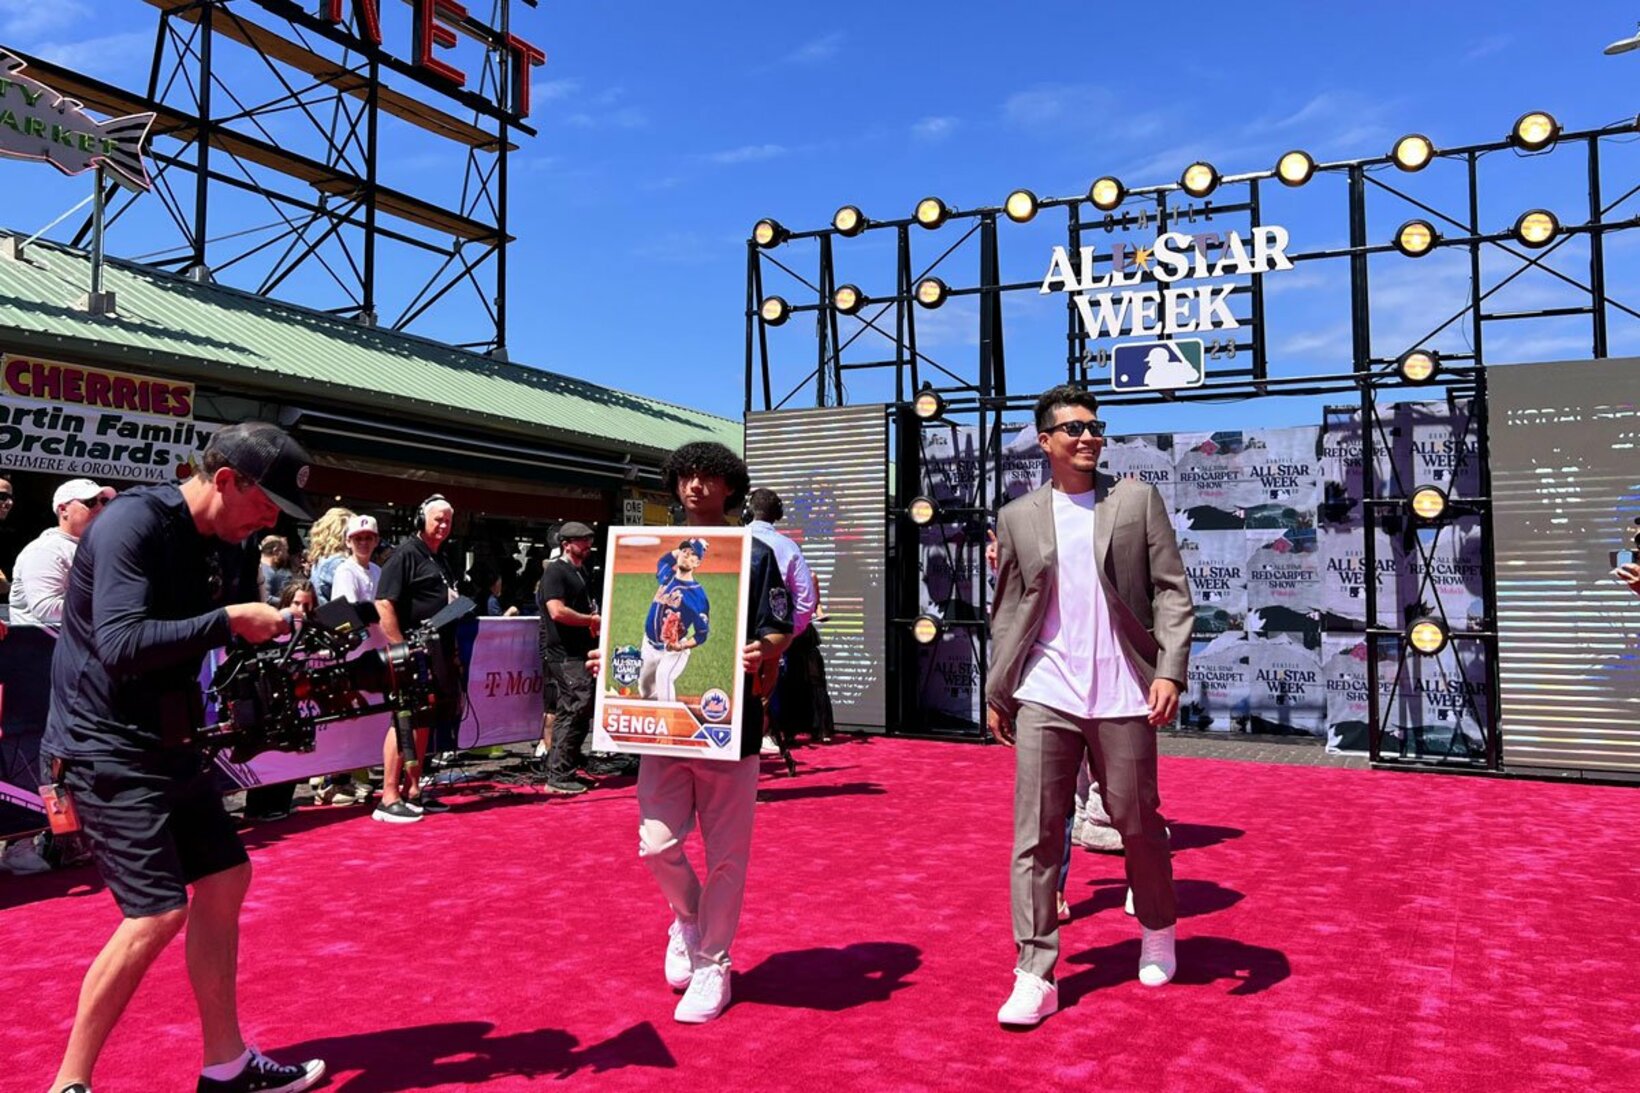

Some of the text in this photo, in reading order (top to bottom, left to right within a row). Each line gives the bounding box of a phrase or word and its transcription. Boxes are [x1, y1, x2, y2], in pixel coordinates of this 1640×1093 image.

[1103, 201, 1213, 233] SEATTLE
[1073, 283, 1240, 340] WEEK
[5, 360, 192, 417] CHERRIES
[96, 413, 213, 450] Family
[0, 453, 64, 471] SHMERE
[67, 460, 78, 472] &
[82, 462, 142, 478] ORONDO
[1250, 464, 1310, 478] ALL STAR
[1139, 470, 1169, 481] STAR
[1180, 471, 1240, 482] RED CARPET
[1197, 481, 1222, 490] SHOW
[1260, 476, 1299, 488] WEEK
[626, 501, 642, 512] ONE
[626, 514, 642, 525] WAY
[1327, 557, 1397, 572] ALL SAR
[1209, 566, 1241, 578] STAR
[1251, 570, 1313, 580] RED CARPET
[1194, 578, 1231, 590] WEEK
[1268, 580, 1296, 589] SHOW
[1431, 575, 1464, 585] SHOW
[1206, 671, 1245, 682] CARPET
[1256, 669, 1316, 682] ALL STAR
[1200, 681, 1228, 690] SHOW
[1267, 681, 1306, 694] WEEK
[1327, 679, 1351, 691] RED
[1414, 678, 1445, 693] ALL
[607, 715, 668, 735] SENGA
